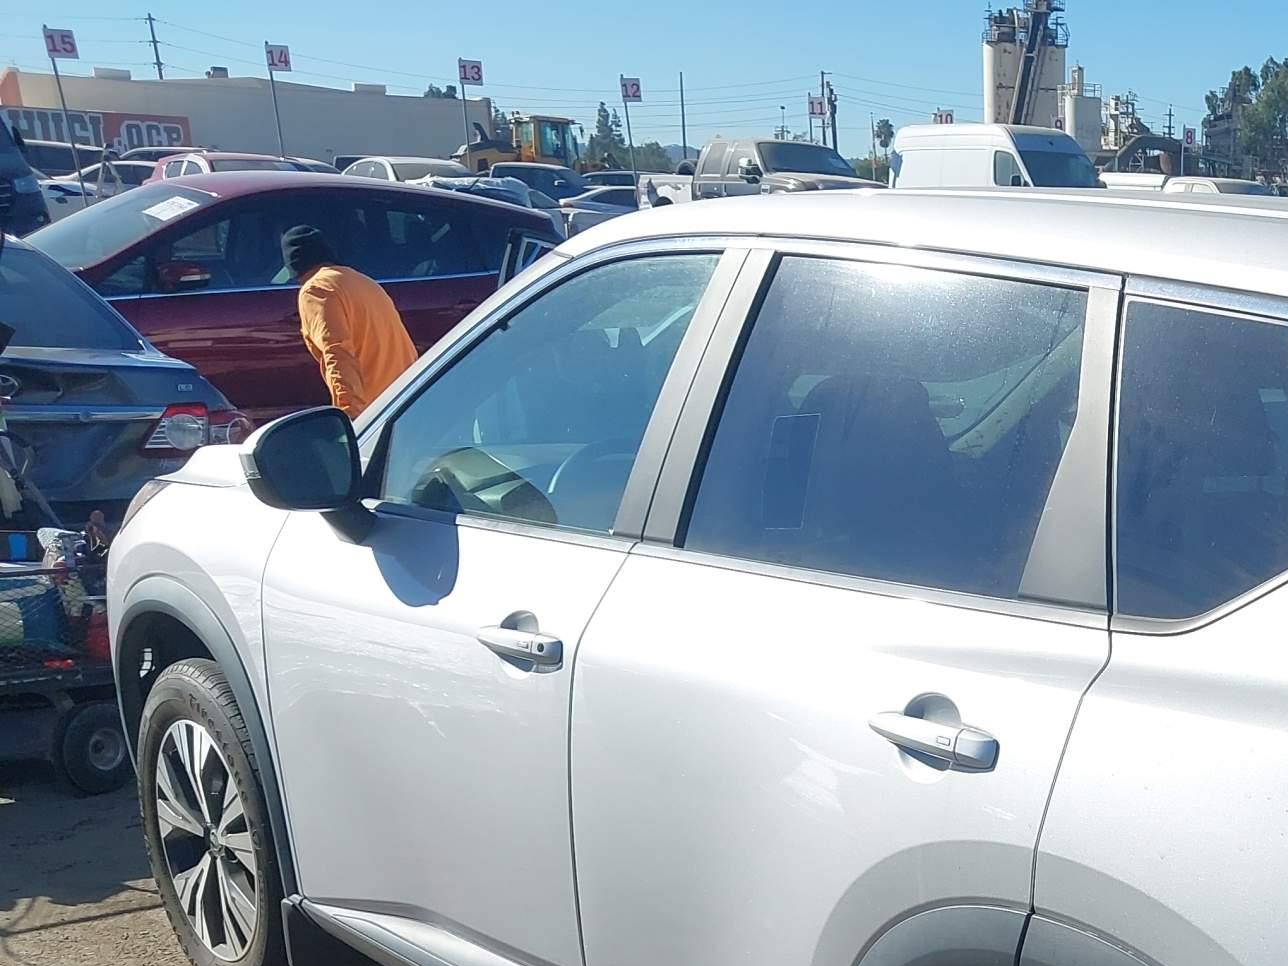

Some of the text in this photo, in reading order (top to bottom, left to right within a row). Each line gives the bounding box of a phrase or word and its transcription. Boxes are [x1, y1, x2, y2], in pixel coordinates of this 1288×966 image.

[47, 34, 76, 53] 15
[267, 50, 289, 67] 14
[459, 64, 482, 81] 13
[622, 83, 641, 98] 12
[809, 101, 826, 115] 11
[1186, 130, 1193, 144] 8
